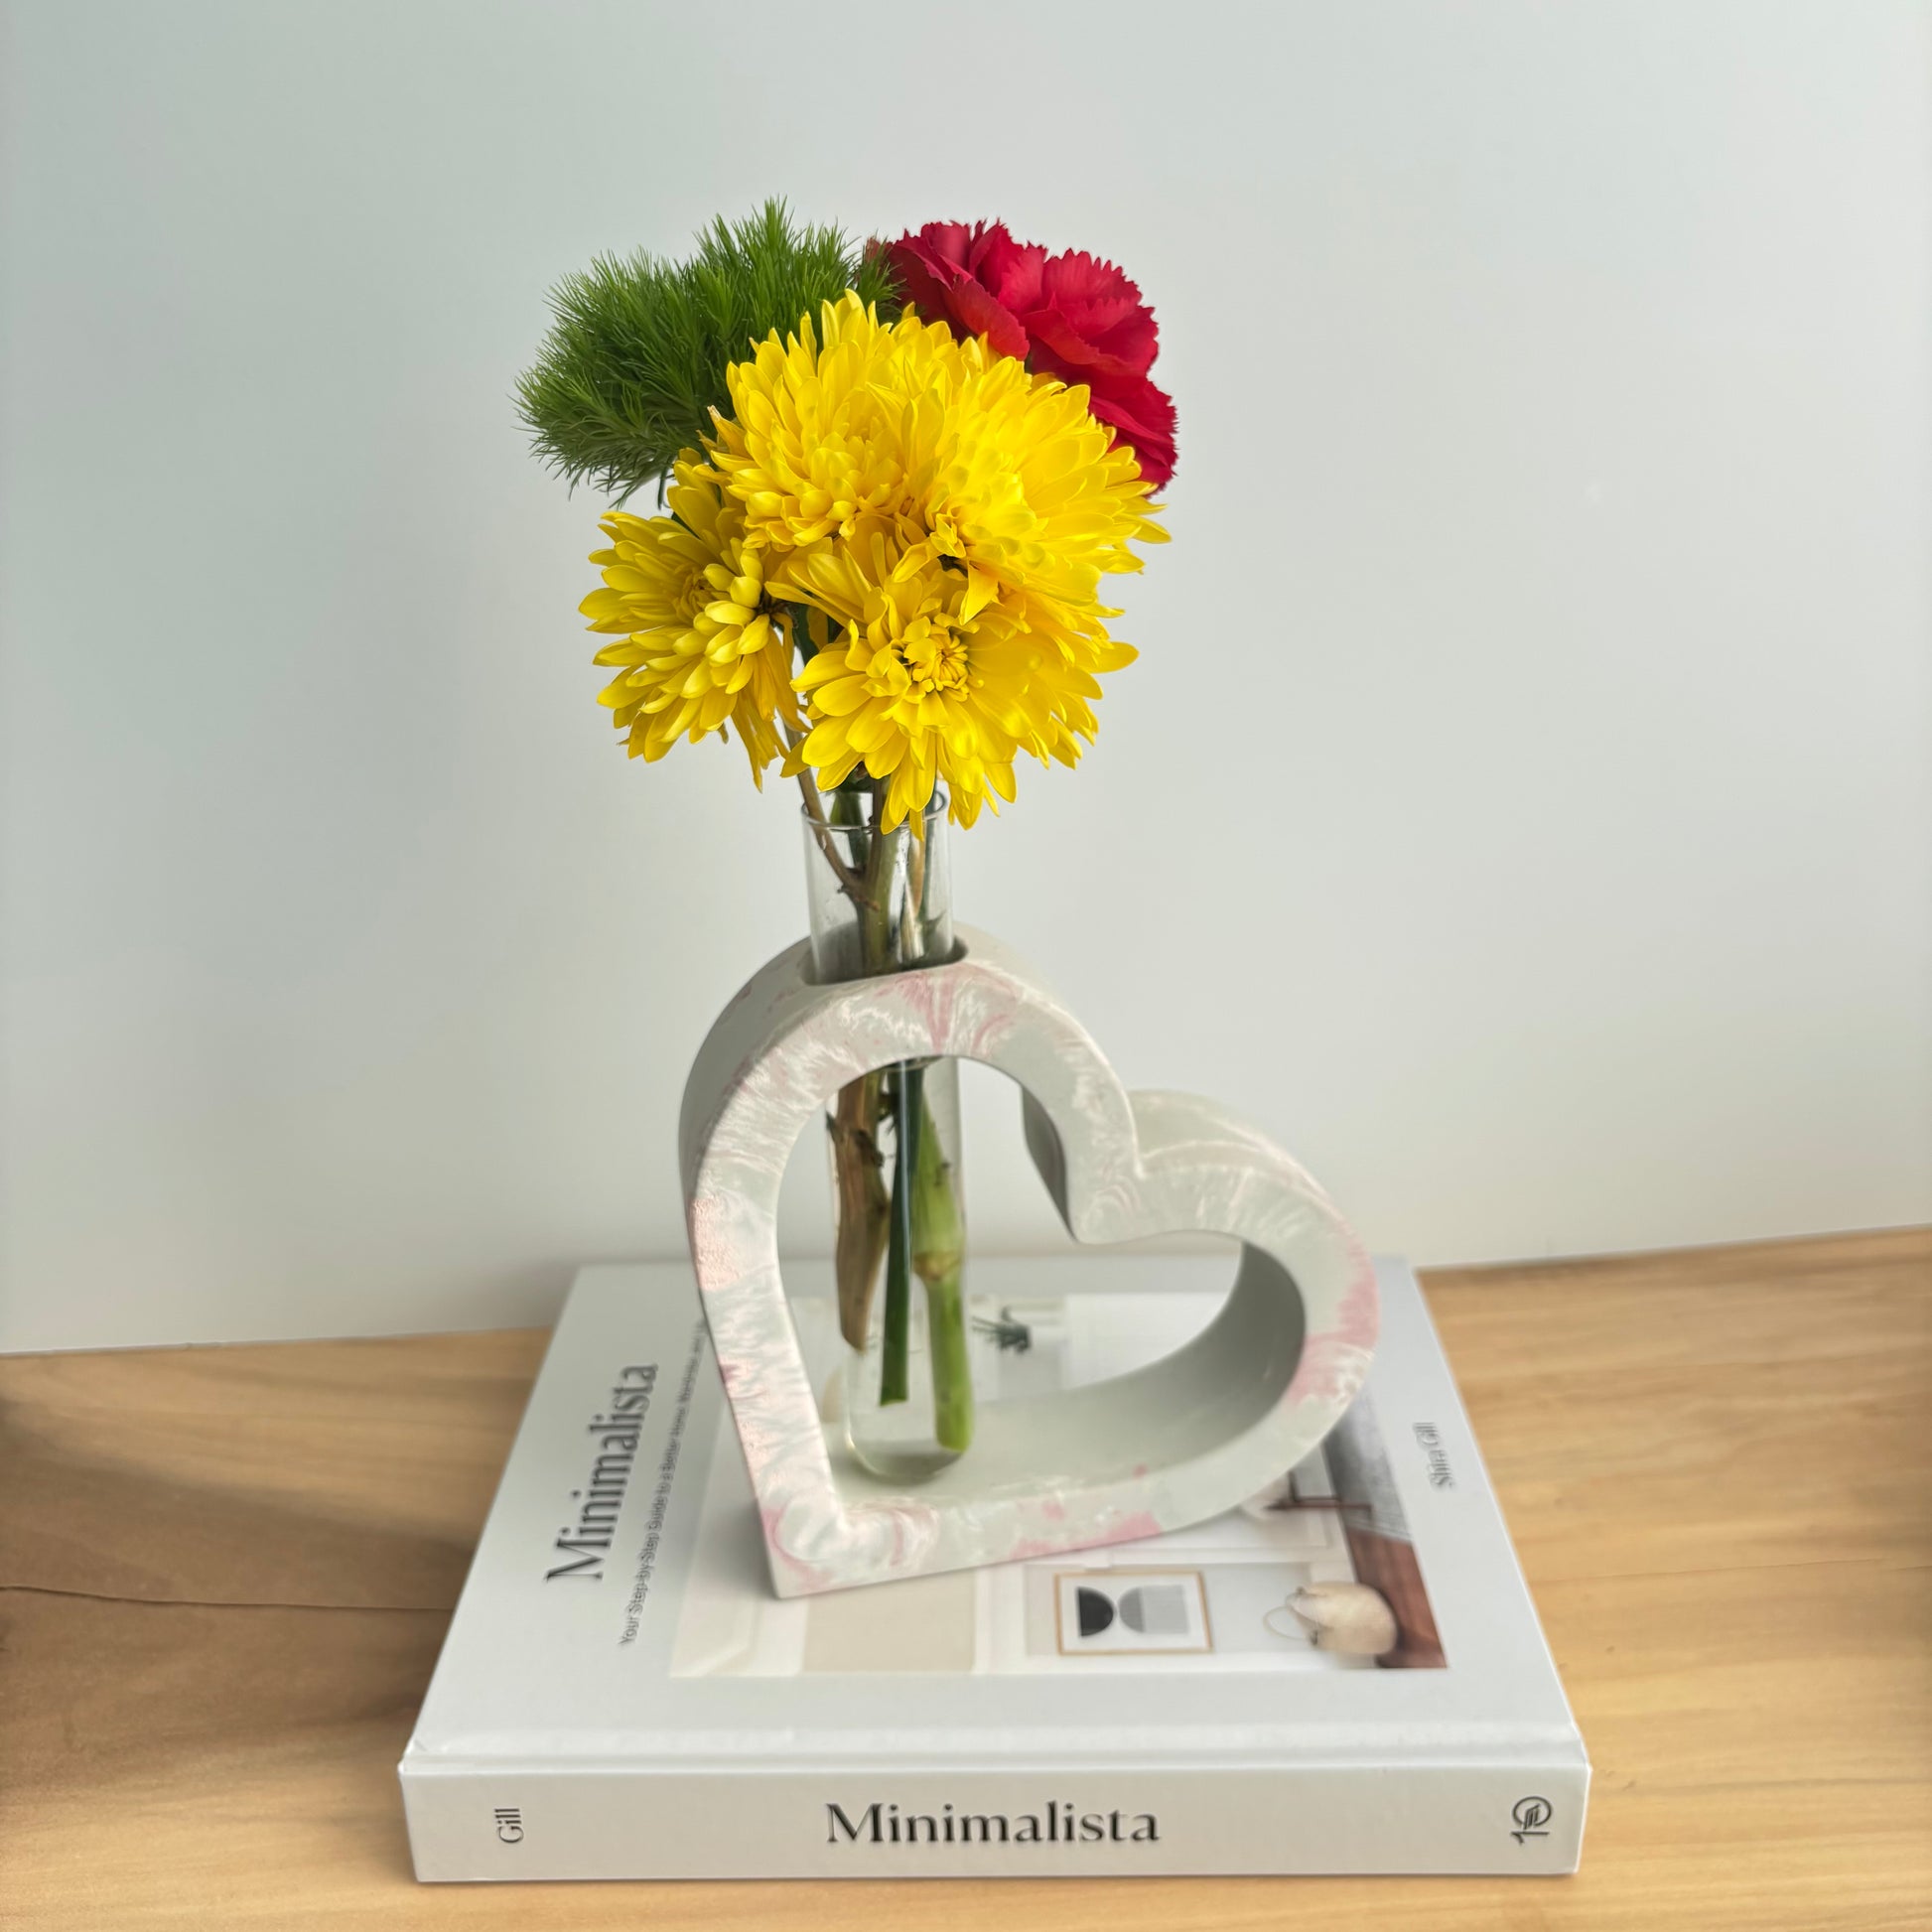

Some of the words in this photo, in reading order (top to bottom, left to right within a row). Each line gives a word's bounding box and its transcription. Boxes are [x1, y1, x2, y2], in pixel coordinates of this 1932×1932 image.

[1413, 1422, 1439, 1449] Gill
[544, 1364, 658, 1583] Minimalista
[645, 1495, 668, 1532] Guide
[625, 1532, 659, 1616] Step-by-Step
[619, 1614, 640, 1647] Your
[494, 1808, 524, 1844] Gill
[826, 1800, 1160, 1843] Minimalista
